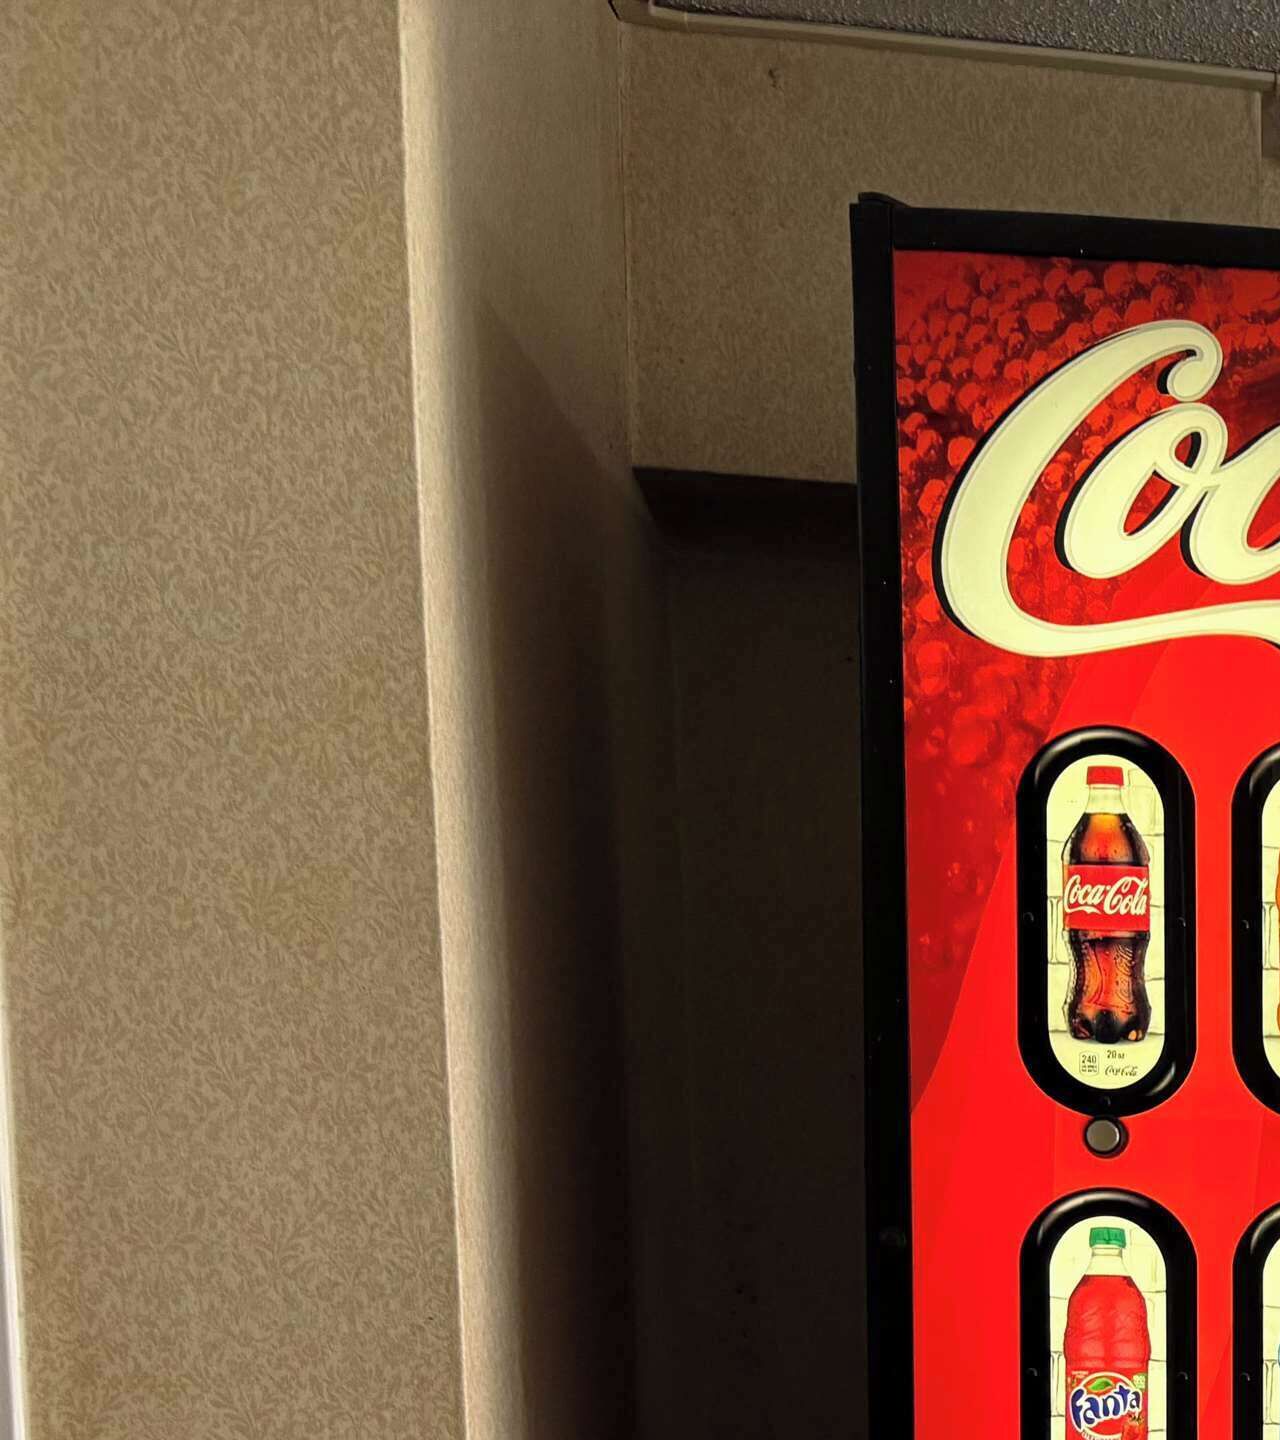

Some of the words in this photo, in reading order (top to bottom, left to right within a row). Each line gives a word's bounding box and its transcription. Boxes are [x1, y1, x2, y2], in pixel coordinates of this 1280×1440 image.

[1064, 875, 1148, 916] Coca-Cola
[1081, 1054, 1097, 1063] 240
[1107, 1050, 1117, 1059] 20
[1070, 1384, 1141, 1431] Fanta
